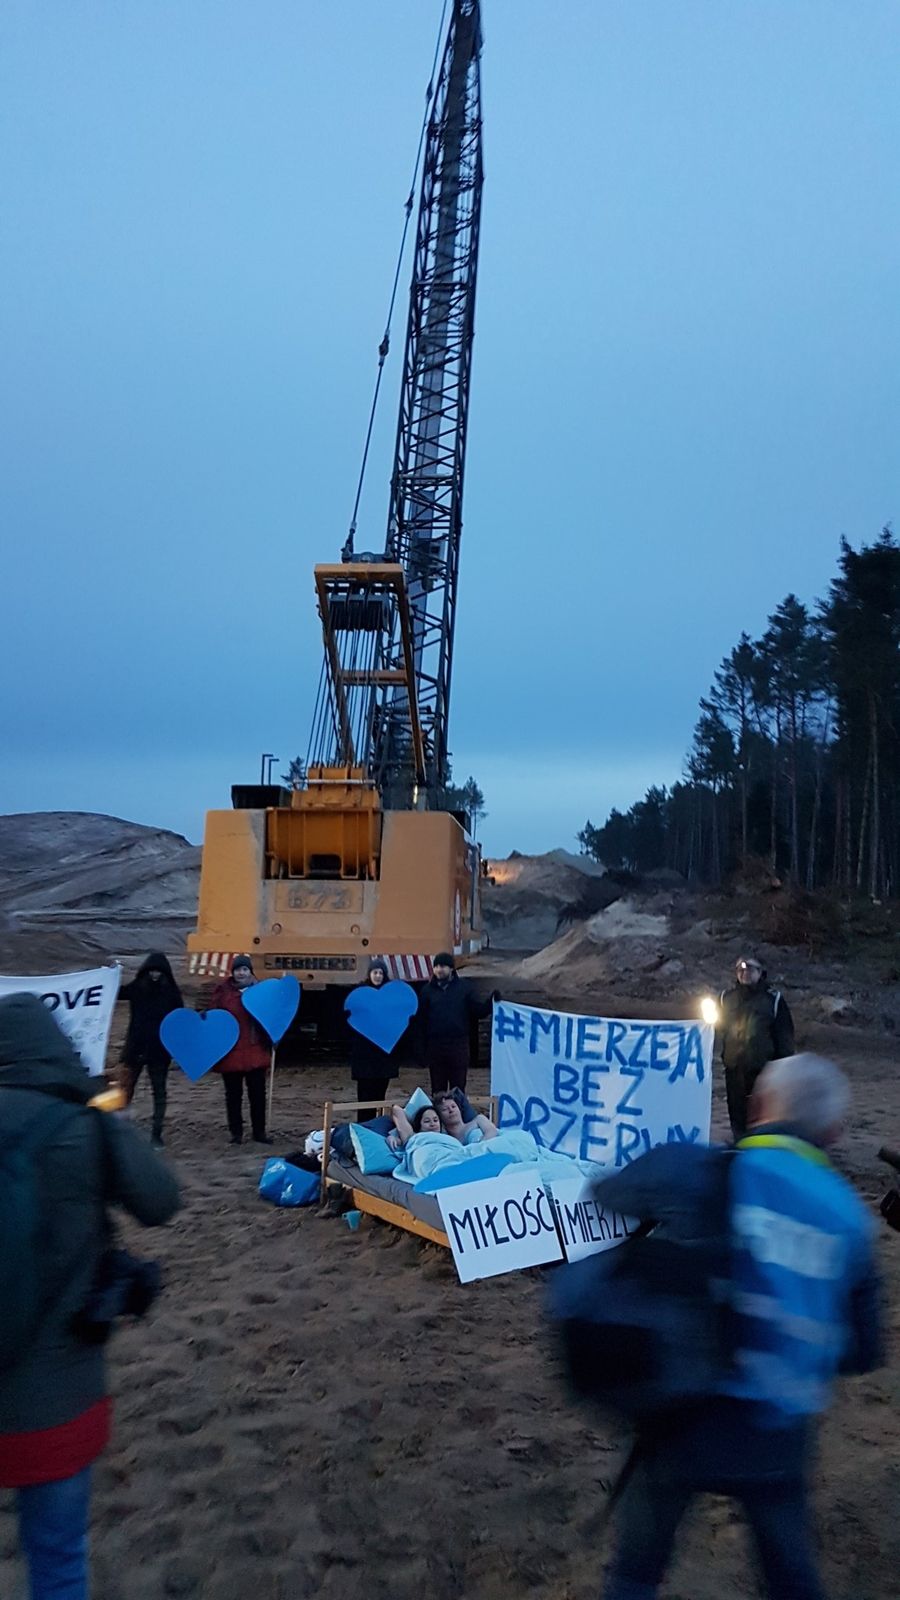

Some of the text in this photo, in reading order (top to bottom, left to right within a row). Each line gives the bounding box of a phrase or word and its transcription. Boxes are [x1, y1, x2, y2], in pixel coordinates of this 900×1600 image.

[39, 985, 103, 1012] OVE
[494, 1006, 705, 1083] #MIERZEJA
[553, 1063, 645, 1116] BEZ
[448, 1187, 554, 1254] MIŁOŚĆ
